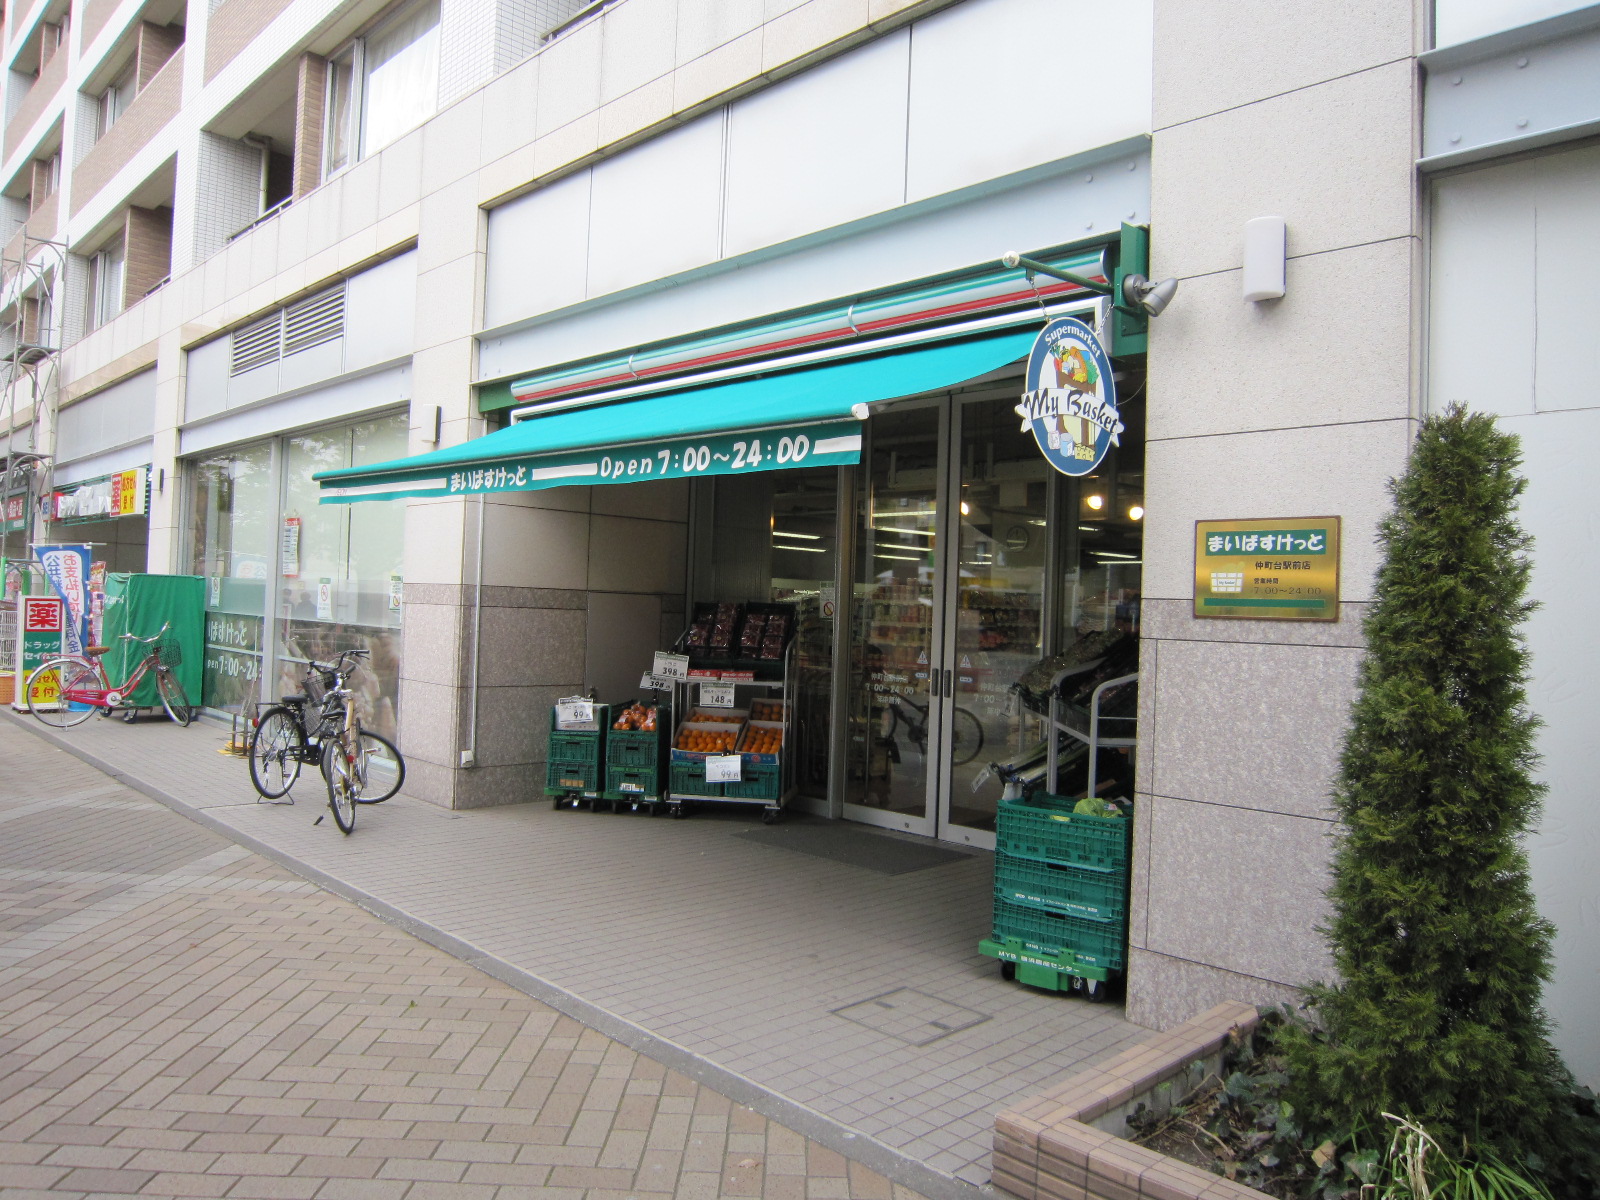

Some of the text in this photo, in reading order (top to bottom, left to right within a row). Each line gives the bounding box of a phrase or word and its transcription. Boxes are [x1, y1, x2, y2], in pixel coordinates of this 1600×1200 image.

[1045, 325, 1101, 358] Supermarket
[1024, 388, 1118, 435] My Basket
[600, 456, 653, 478] Open
[450, 466, 527, 492] まいばすけっと
[1208, 534, 1323, 552] まいばすけっと
[1255, 561, 1311, 570] 仲町台駅前店
[29, 603, 58, 628] 薬
[24, 641, 60, 649] ドラッグ
[662, 667, 677, 676] 398
[31, 686, 55, 698] 受付
[711, 695, 724, 703] 148
[998, 950, 1017, 959] MYB
